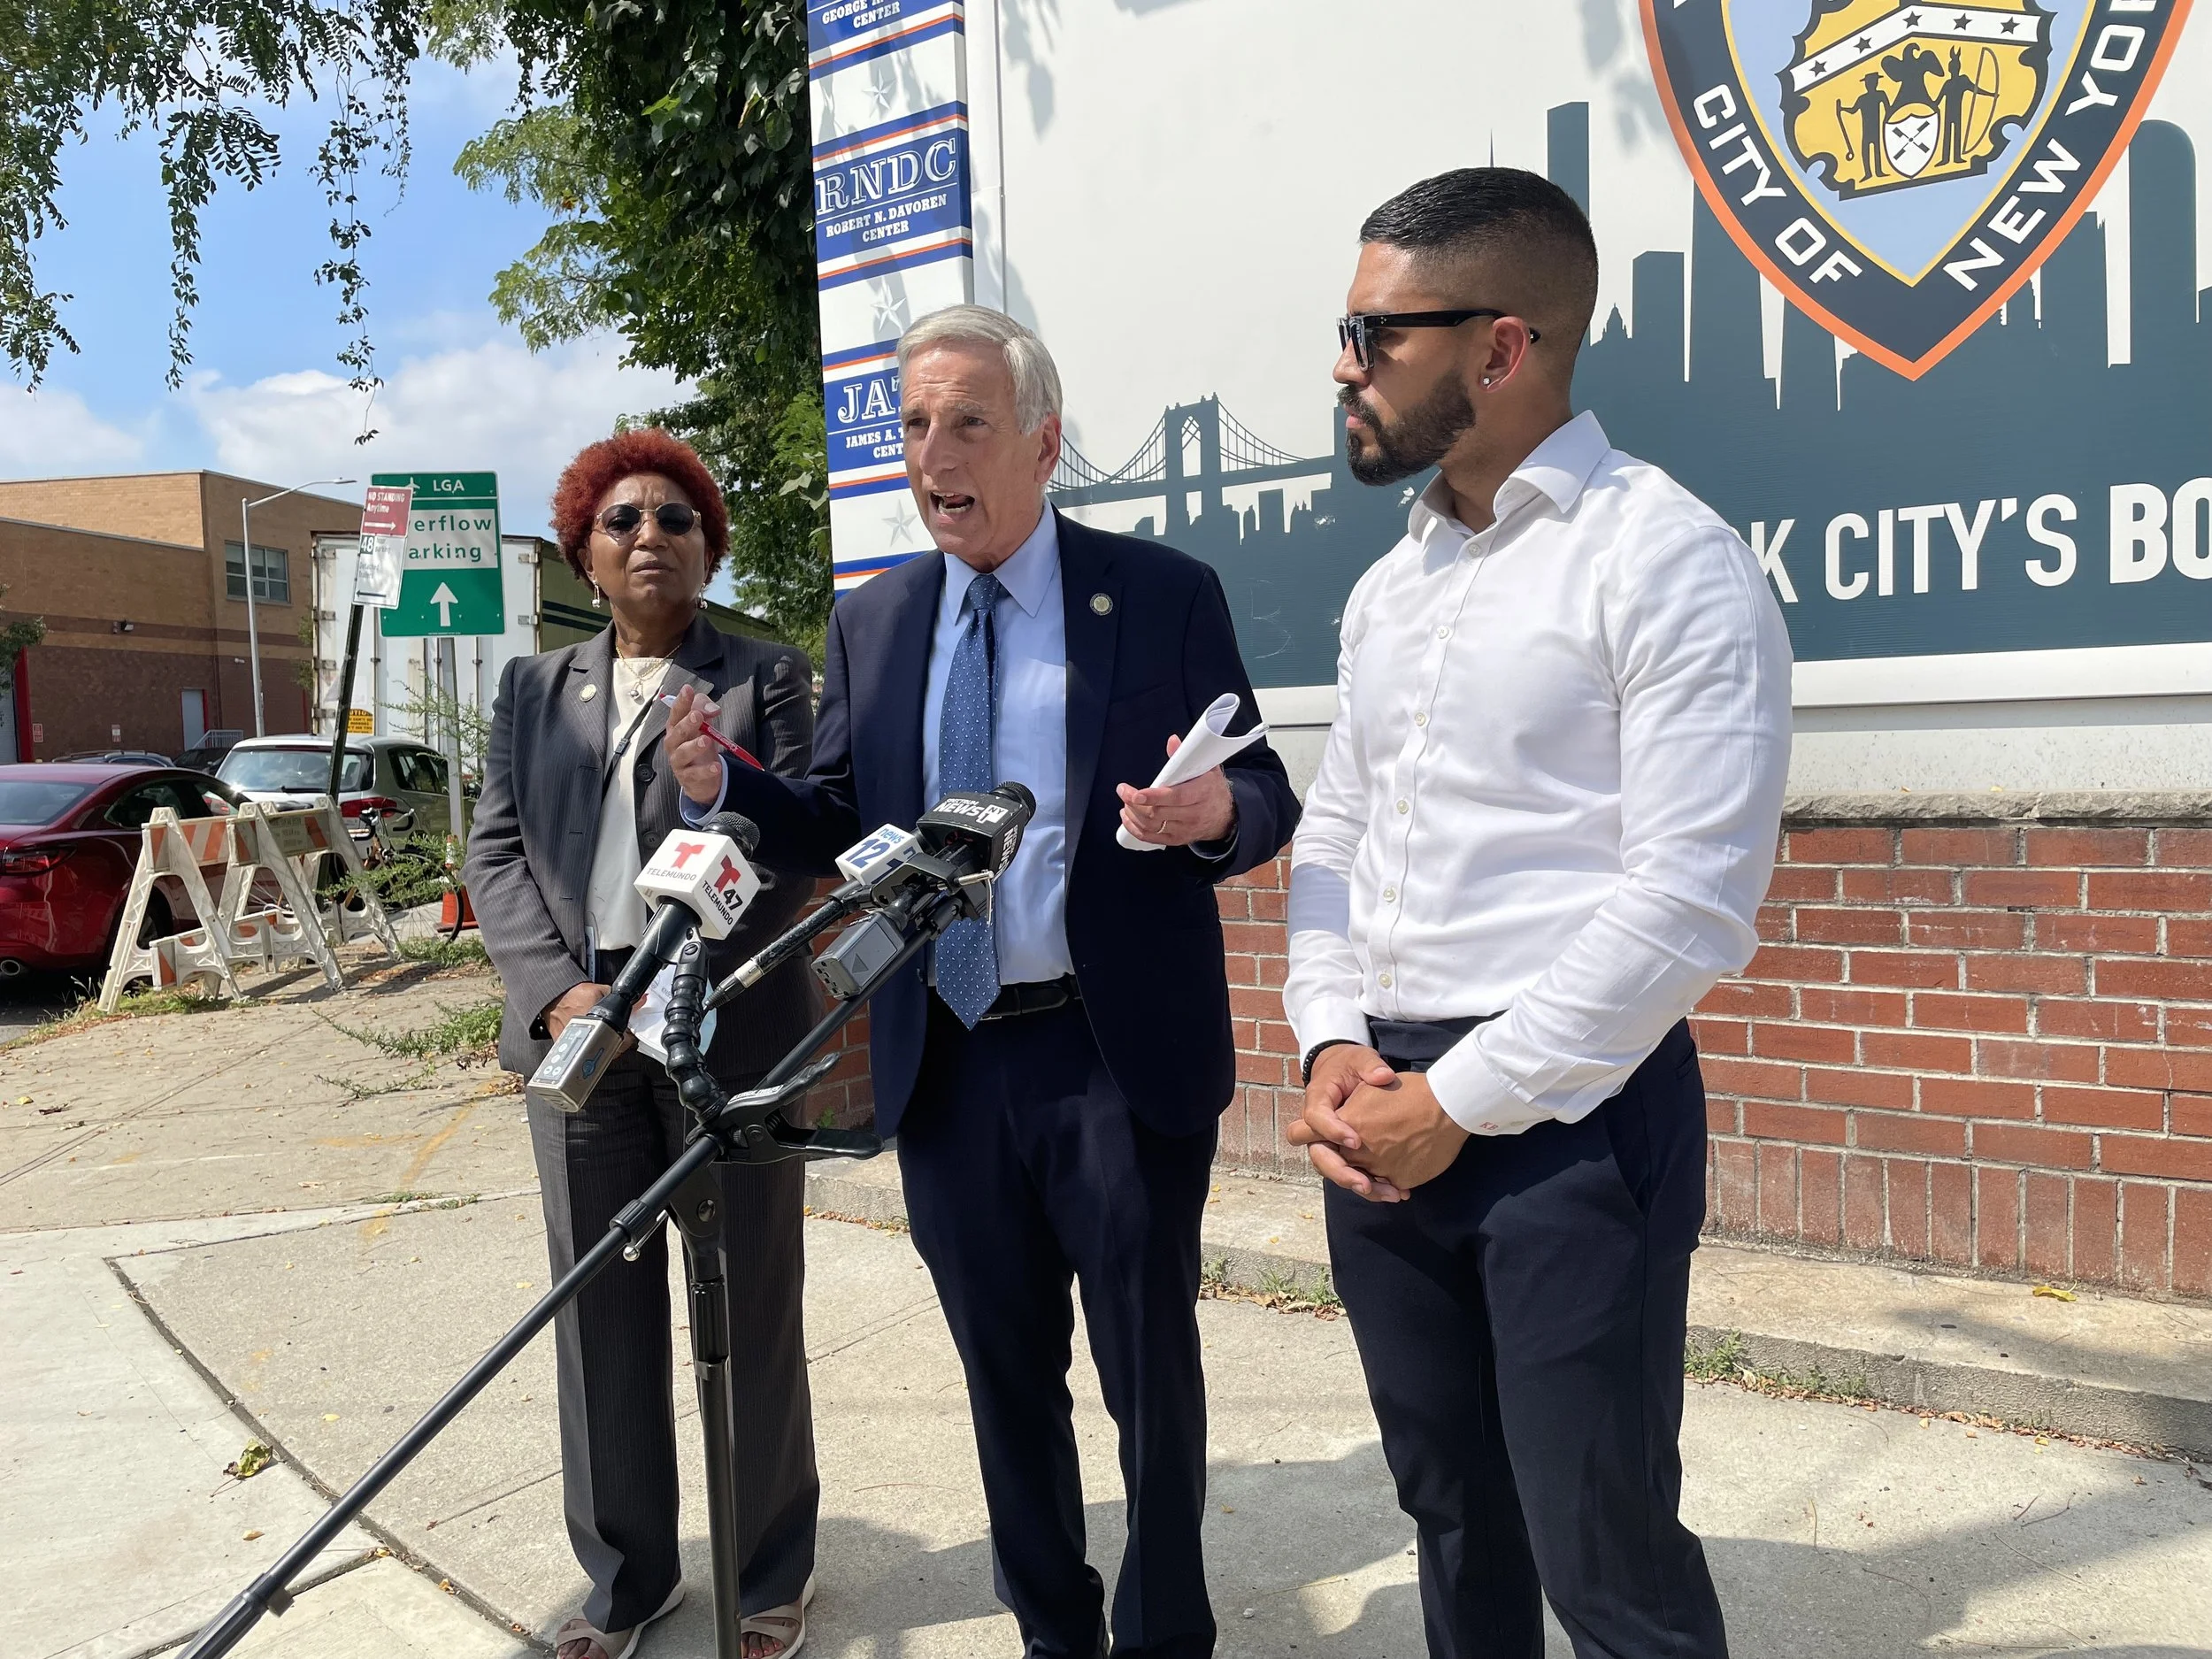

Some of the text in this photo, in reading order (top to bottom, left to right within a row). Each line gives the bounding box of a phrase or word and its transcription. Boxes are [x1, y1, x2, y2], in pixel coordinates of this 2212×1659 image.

[822, 0, 868, 25] GEORGE
[853, 1, 901, 28] CENTER
[1694, 0, 2157, 292] CITY OF NEW YO
[815, 137, 956, 216] RNDC
[826, 193, 947, 238] ROBERT N. DAVOREN
[862, 219, 910, 242] CENTER
[845, 430, 881, 449] JAMES
[884, 428, 896, 442] A.
[872, 442, 903, 459] CENT
[433, 479, 465, 492] LGA
[368, 491, 405, 503] NO STANDING
[366, 503, 390, 515] Anytime
[408, 515, 492, 532] erflow
[360, 535, 374, 553] 48
[408, 542, 481, 563] arking
[1824, 493, 2078, 601] CITY'S
[933, 802, 986, 817] NEWS
[877, 827, 905, 844] news
[845, 838, 891, 869] 12
[646, 867, 697, 881] TELEMUNDO
[702, 879, 733, 926] TELEMUNDO
[723, 888, 744, 911] 47
